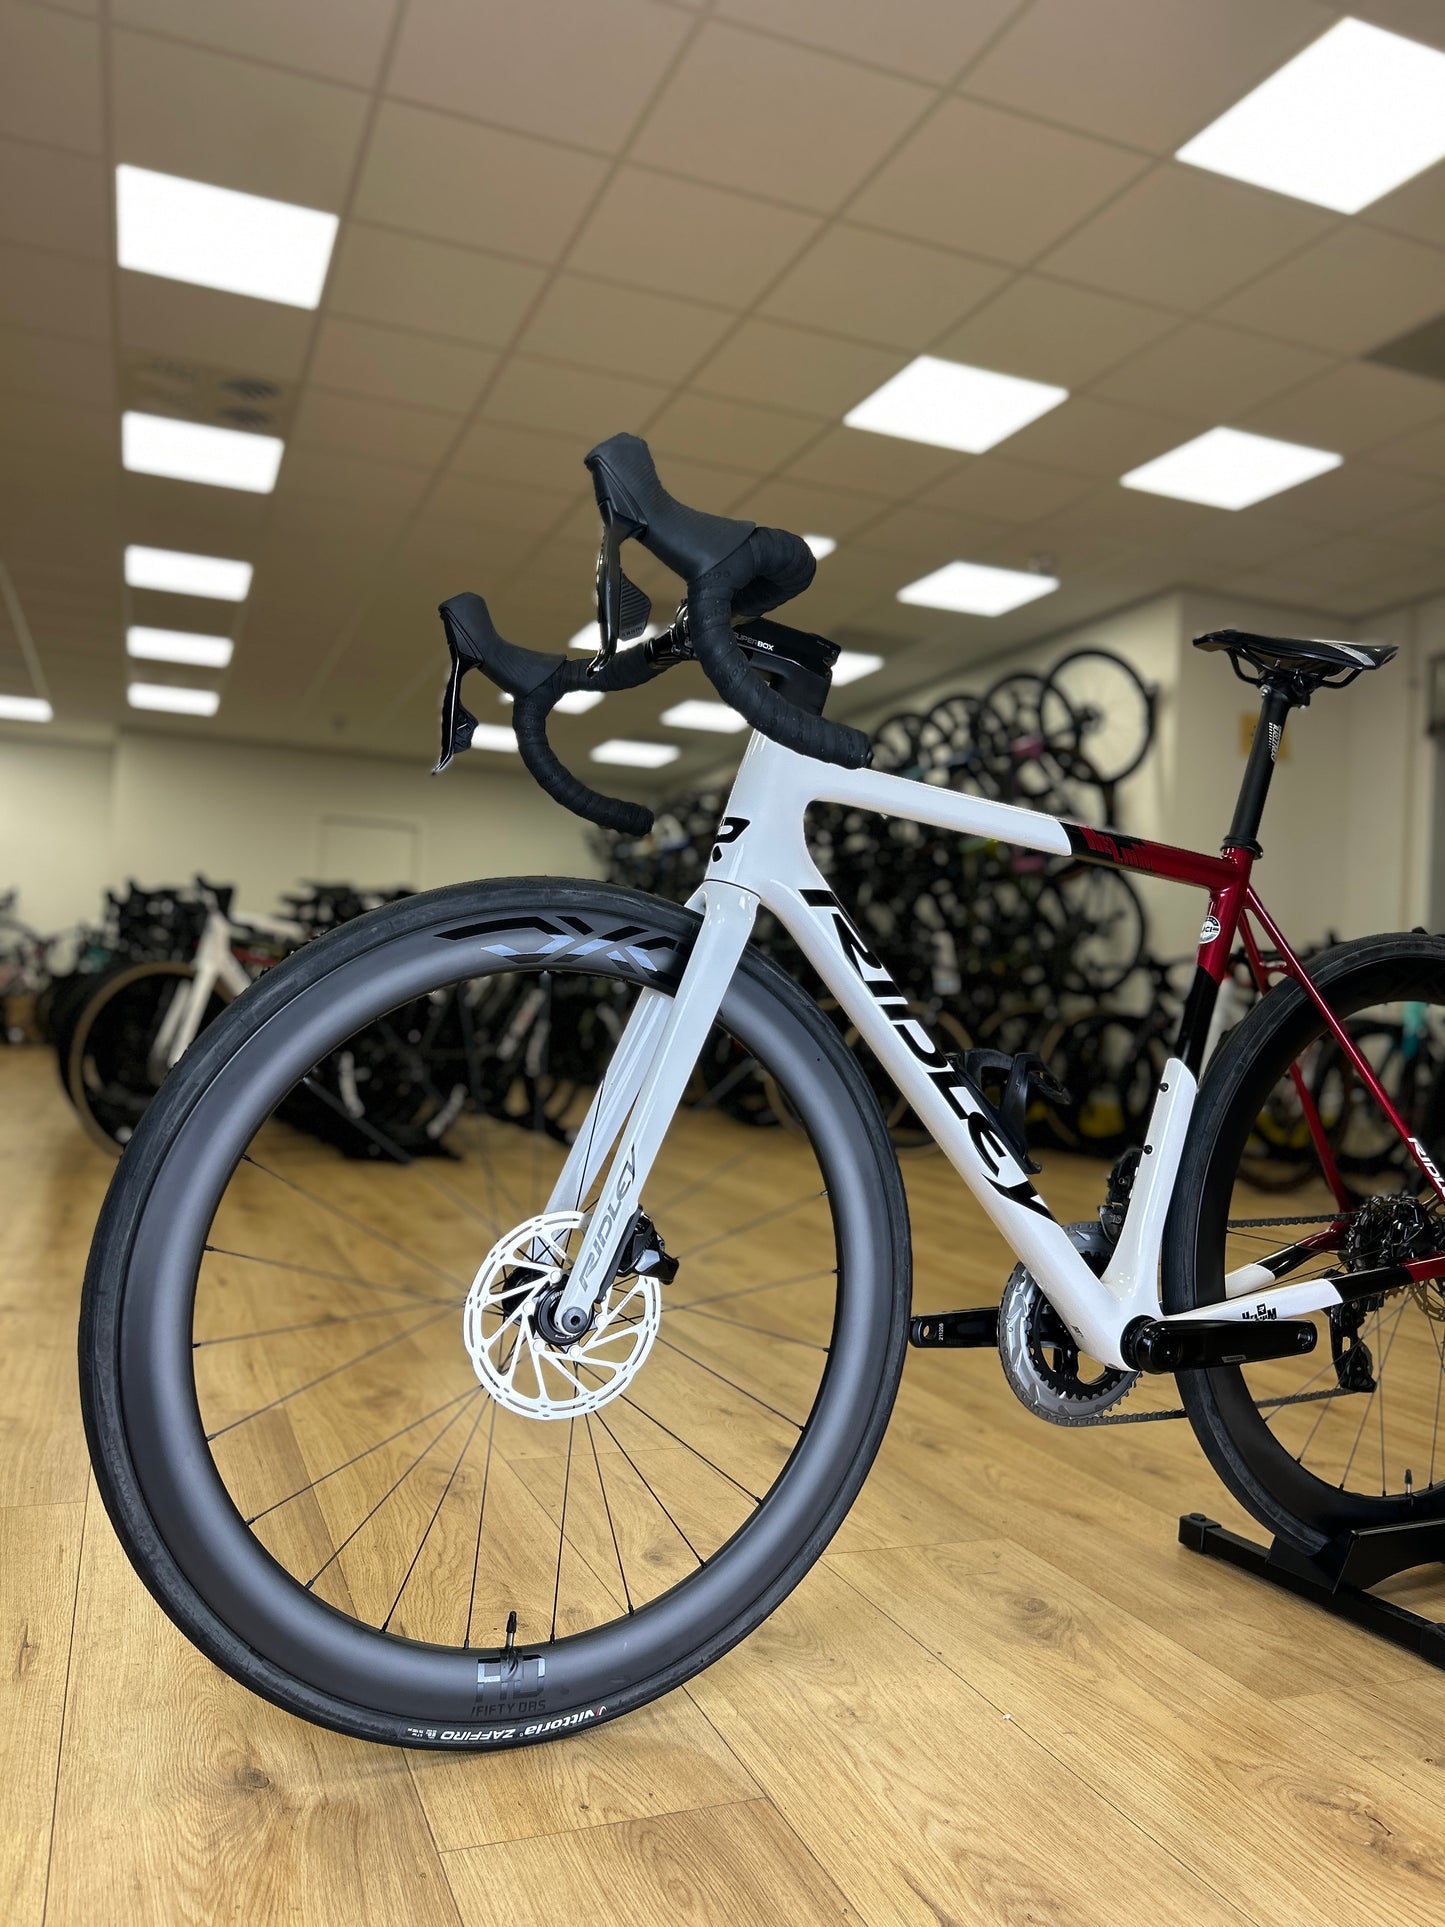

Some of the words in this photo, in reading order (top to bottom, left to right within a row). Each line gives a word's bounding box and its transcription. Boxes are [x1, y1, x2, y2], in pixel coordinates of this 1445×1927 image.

[797, 888, 1063, 1228] RIDLEY
[579, 1143, 636, 1292] RIDLEY
[1407, 1137, 1445, 1198] RIDL
[440, 1728, 516, 1741] ZAFFIRO
